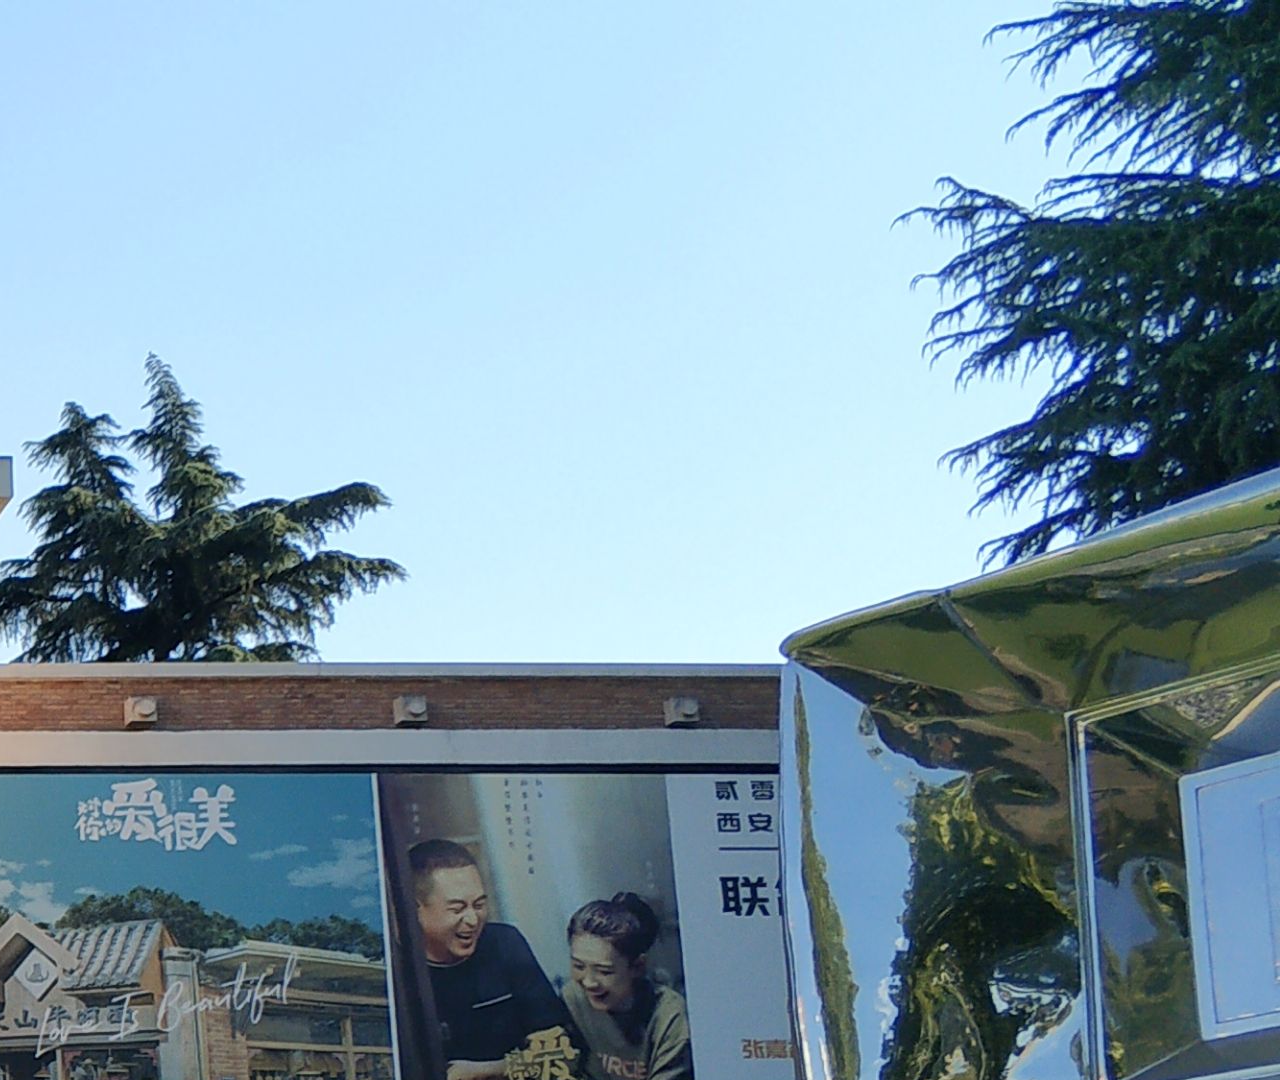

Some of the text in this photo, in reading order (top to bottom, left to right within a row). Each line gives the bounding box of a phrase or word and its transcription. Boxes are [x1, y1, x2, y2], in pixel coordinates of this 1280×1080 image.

[716, 812, 774, 833] 西安
[719, 876, 782, 917] 联
[156, 952, 300, 1032] Beautiful
